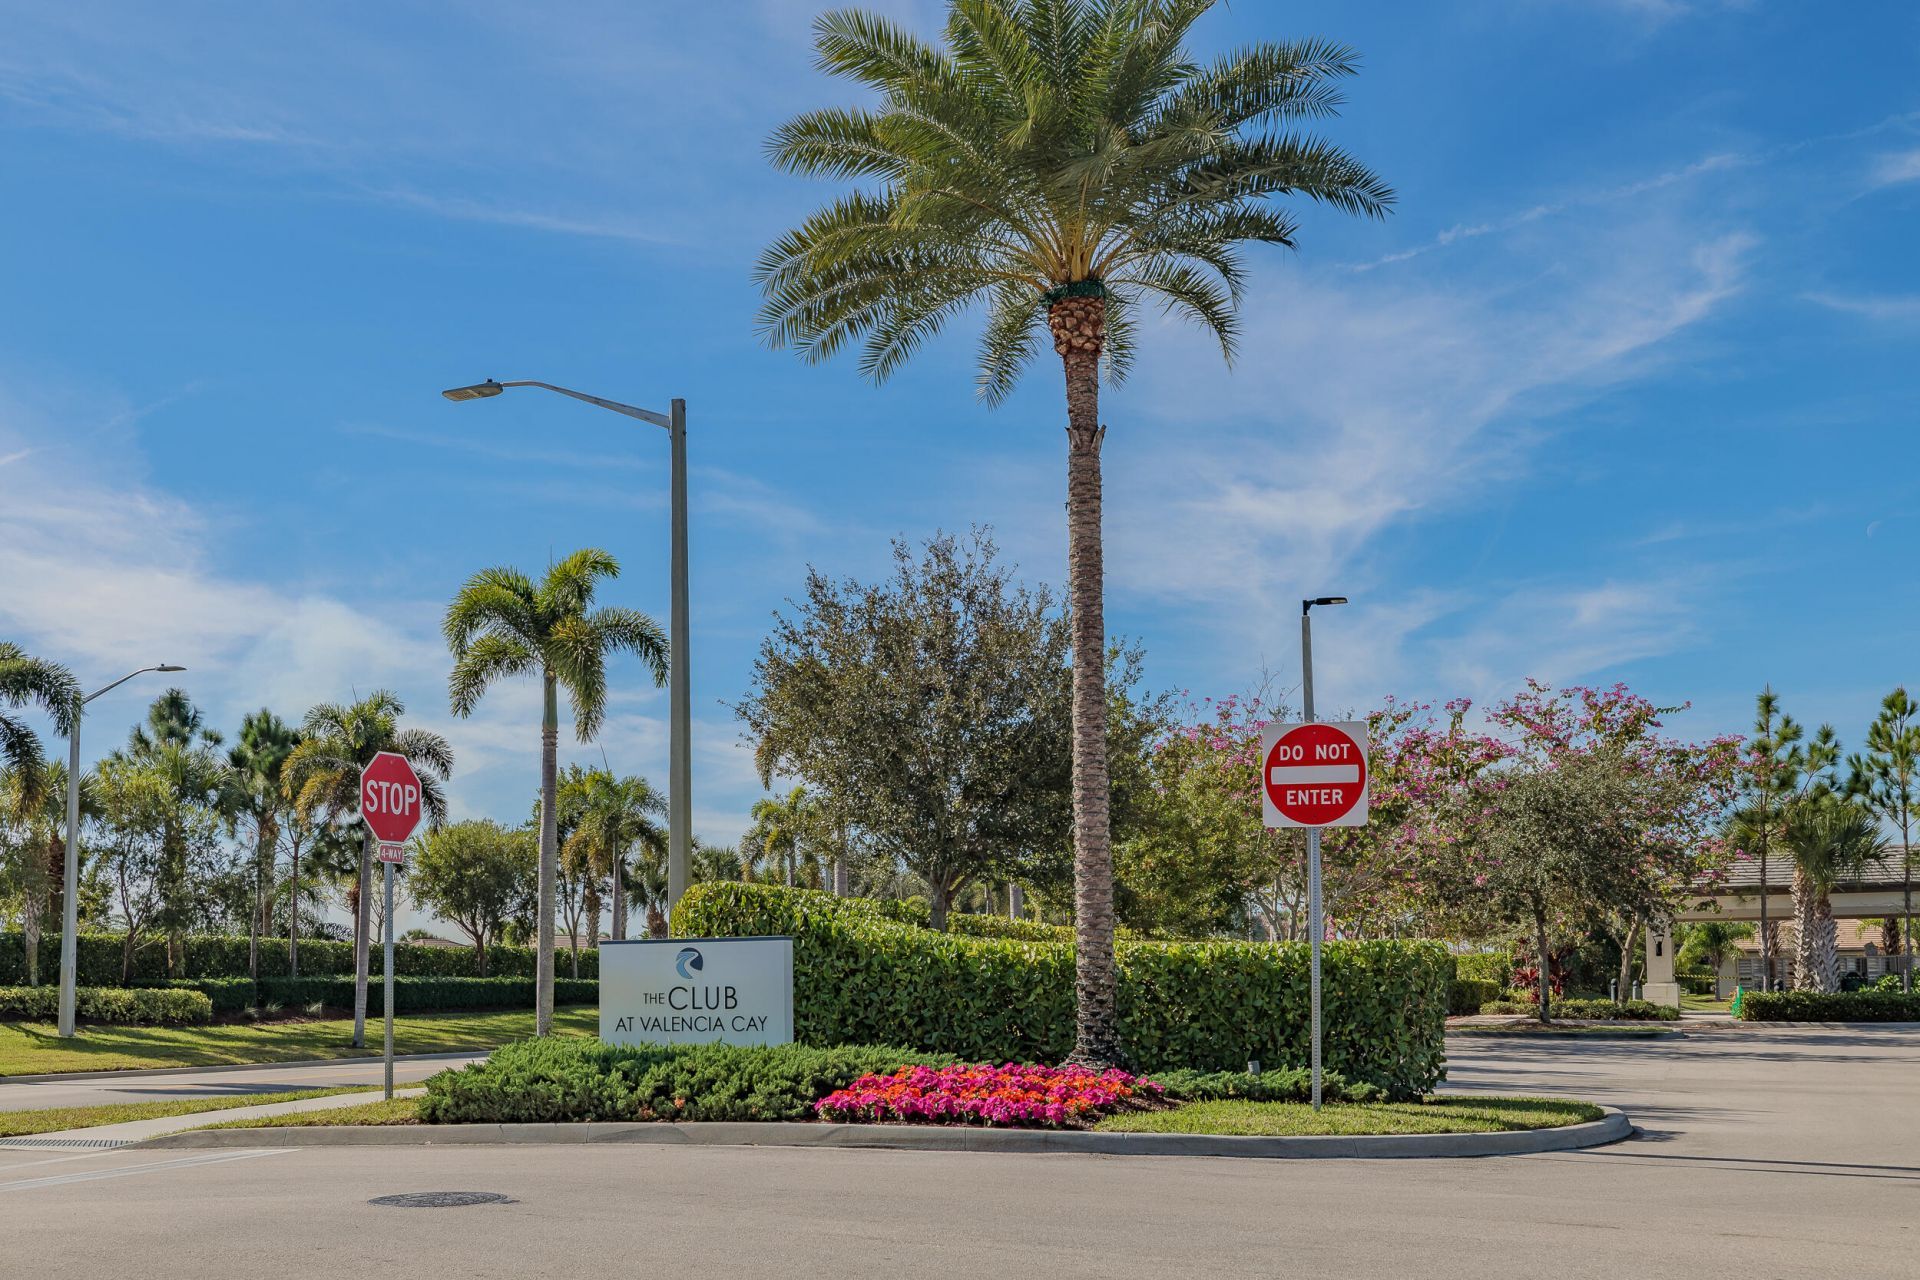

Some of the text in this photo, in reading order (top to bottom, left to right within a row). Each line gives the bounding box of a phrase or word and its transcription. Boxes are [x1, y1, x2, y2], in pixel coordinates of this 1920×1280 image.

[1279, 743, 1351, 761] DO NOT
[365, 779, 418, 816] STOP
[1286, 789, 1343, 806] ENTER
[381, 848, 402, 860] 4-WAY
[643, 986, 738, 1011] THE CLUB
[615, 1015, 768, 1032] AT VALENCIA CAY
